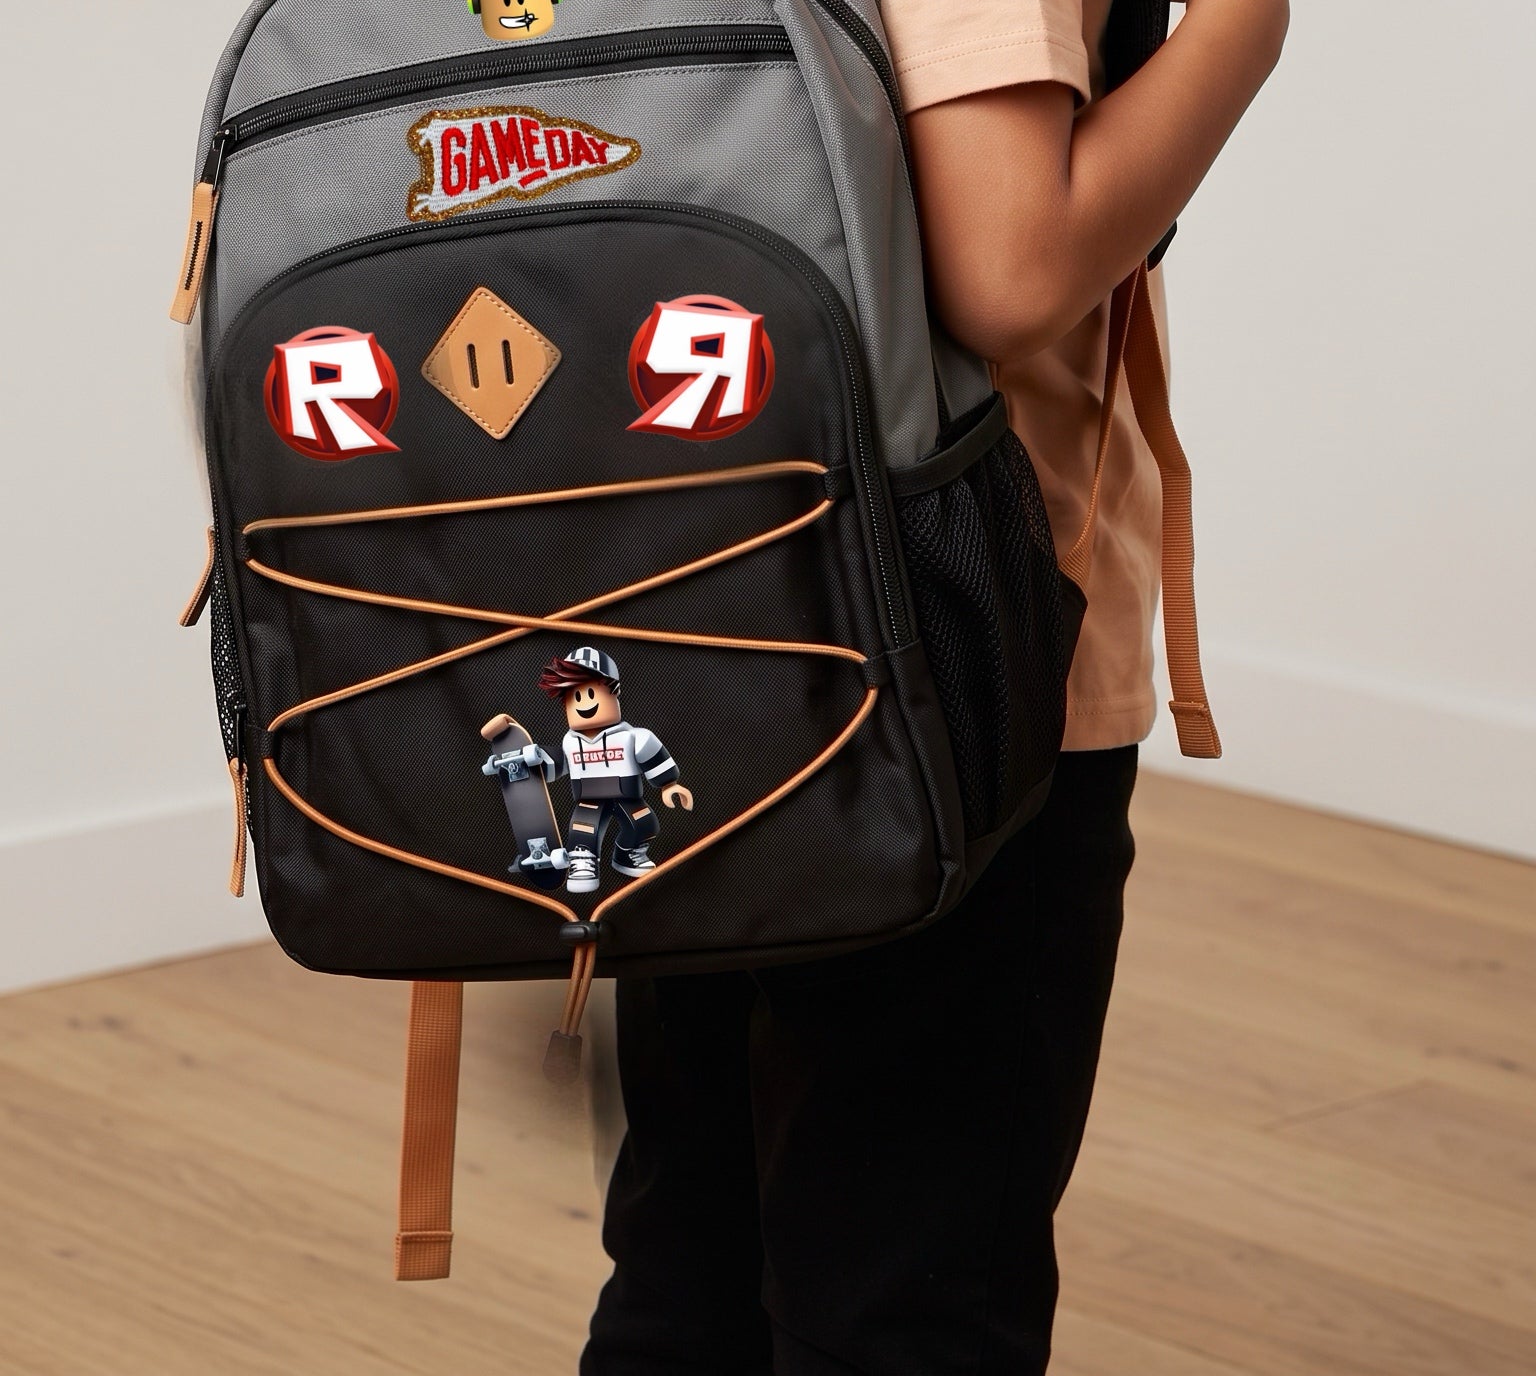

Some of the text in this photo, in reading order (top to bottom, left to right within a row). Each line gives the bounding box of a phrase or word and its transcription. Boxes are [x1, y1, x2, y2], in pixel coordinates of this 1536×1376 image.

[441, 117, 609, 197] GAME DAY
[274, 332, 401, 453] R
